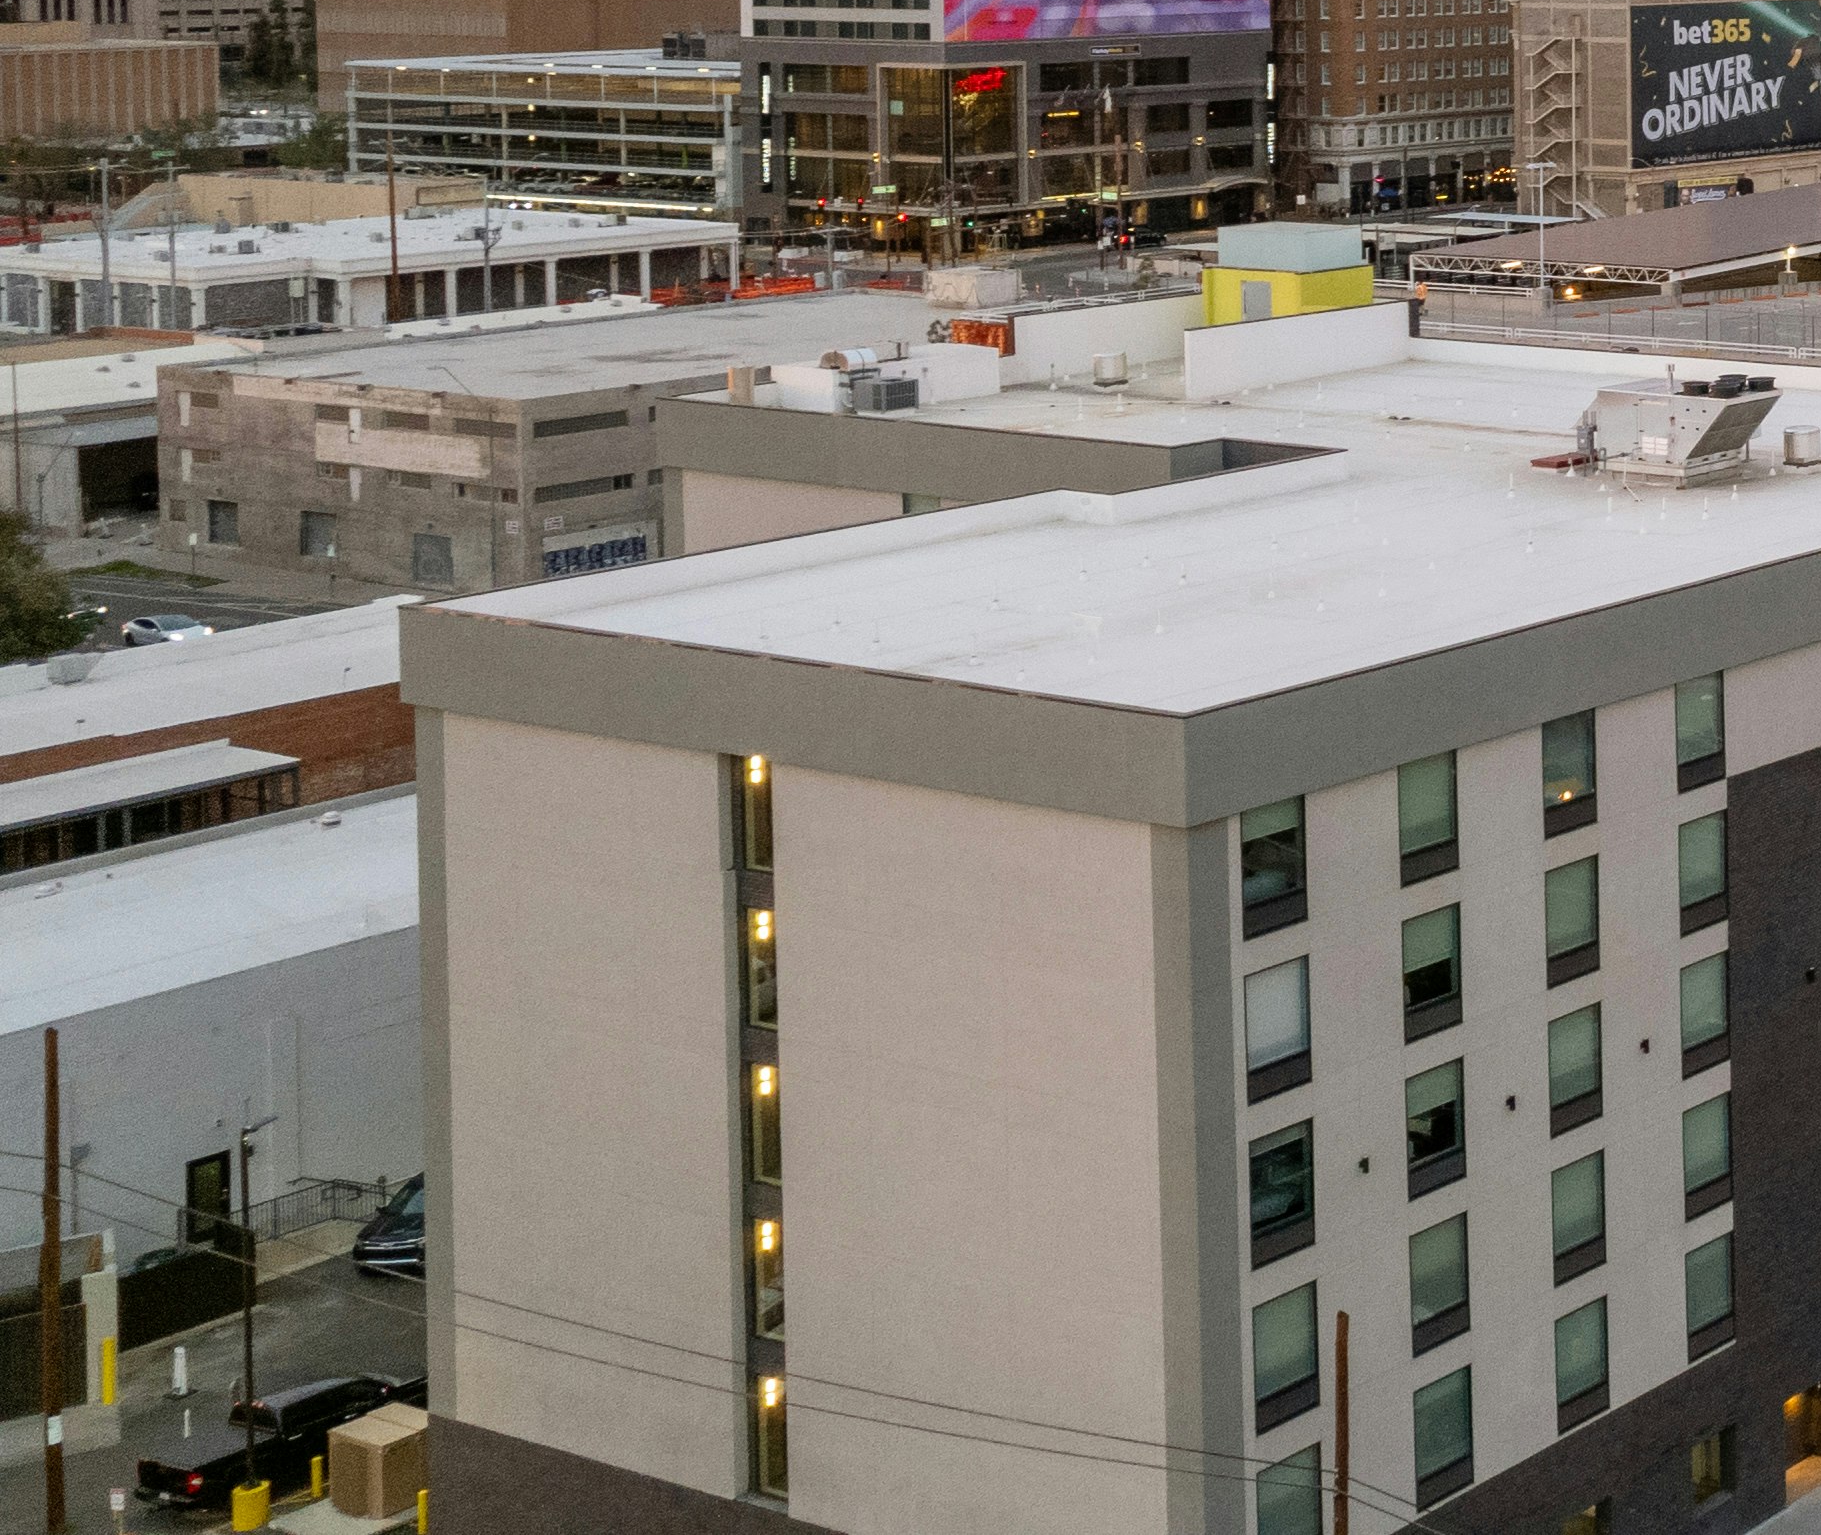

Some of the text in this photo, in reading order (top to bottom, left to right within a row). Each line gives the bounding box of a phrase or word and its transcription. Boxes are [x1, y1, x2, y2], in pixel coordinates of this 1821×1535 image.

[1673, 18, 1751, 46] bet365
[1669, 53, 1754, 103] NEVER
[1641, 76, 1786, 142] ORDINARY
